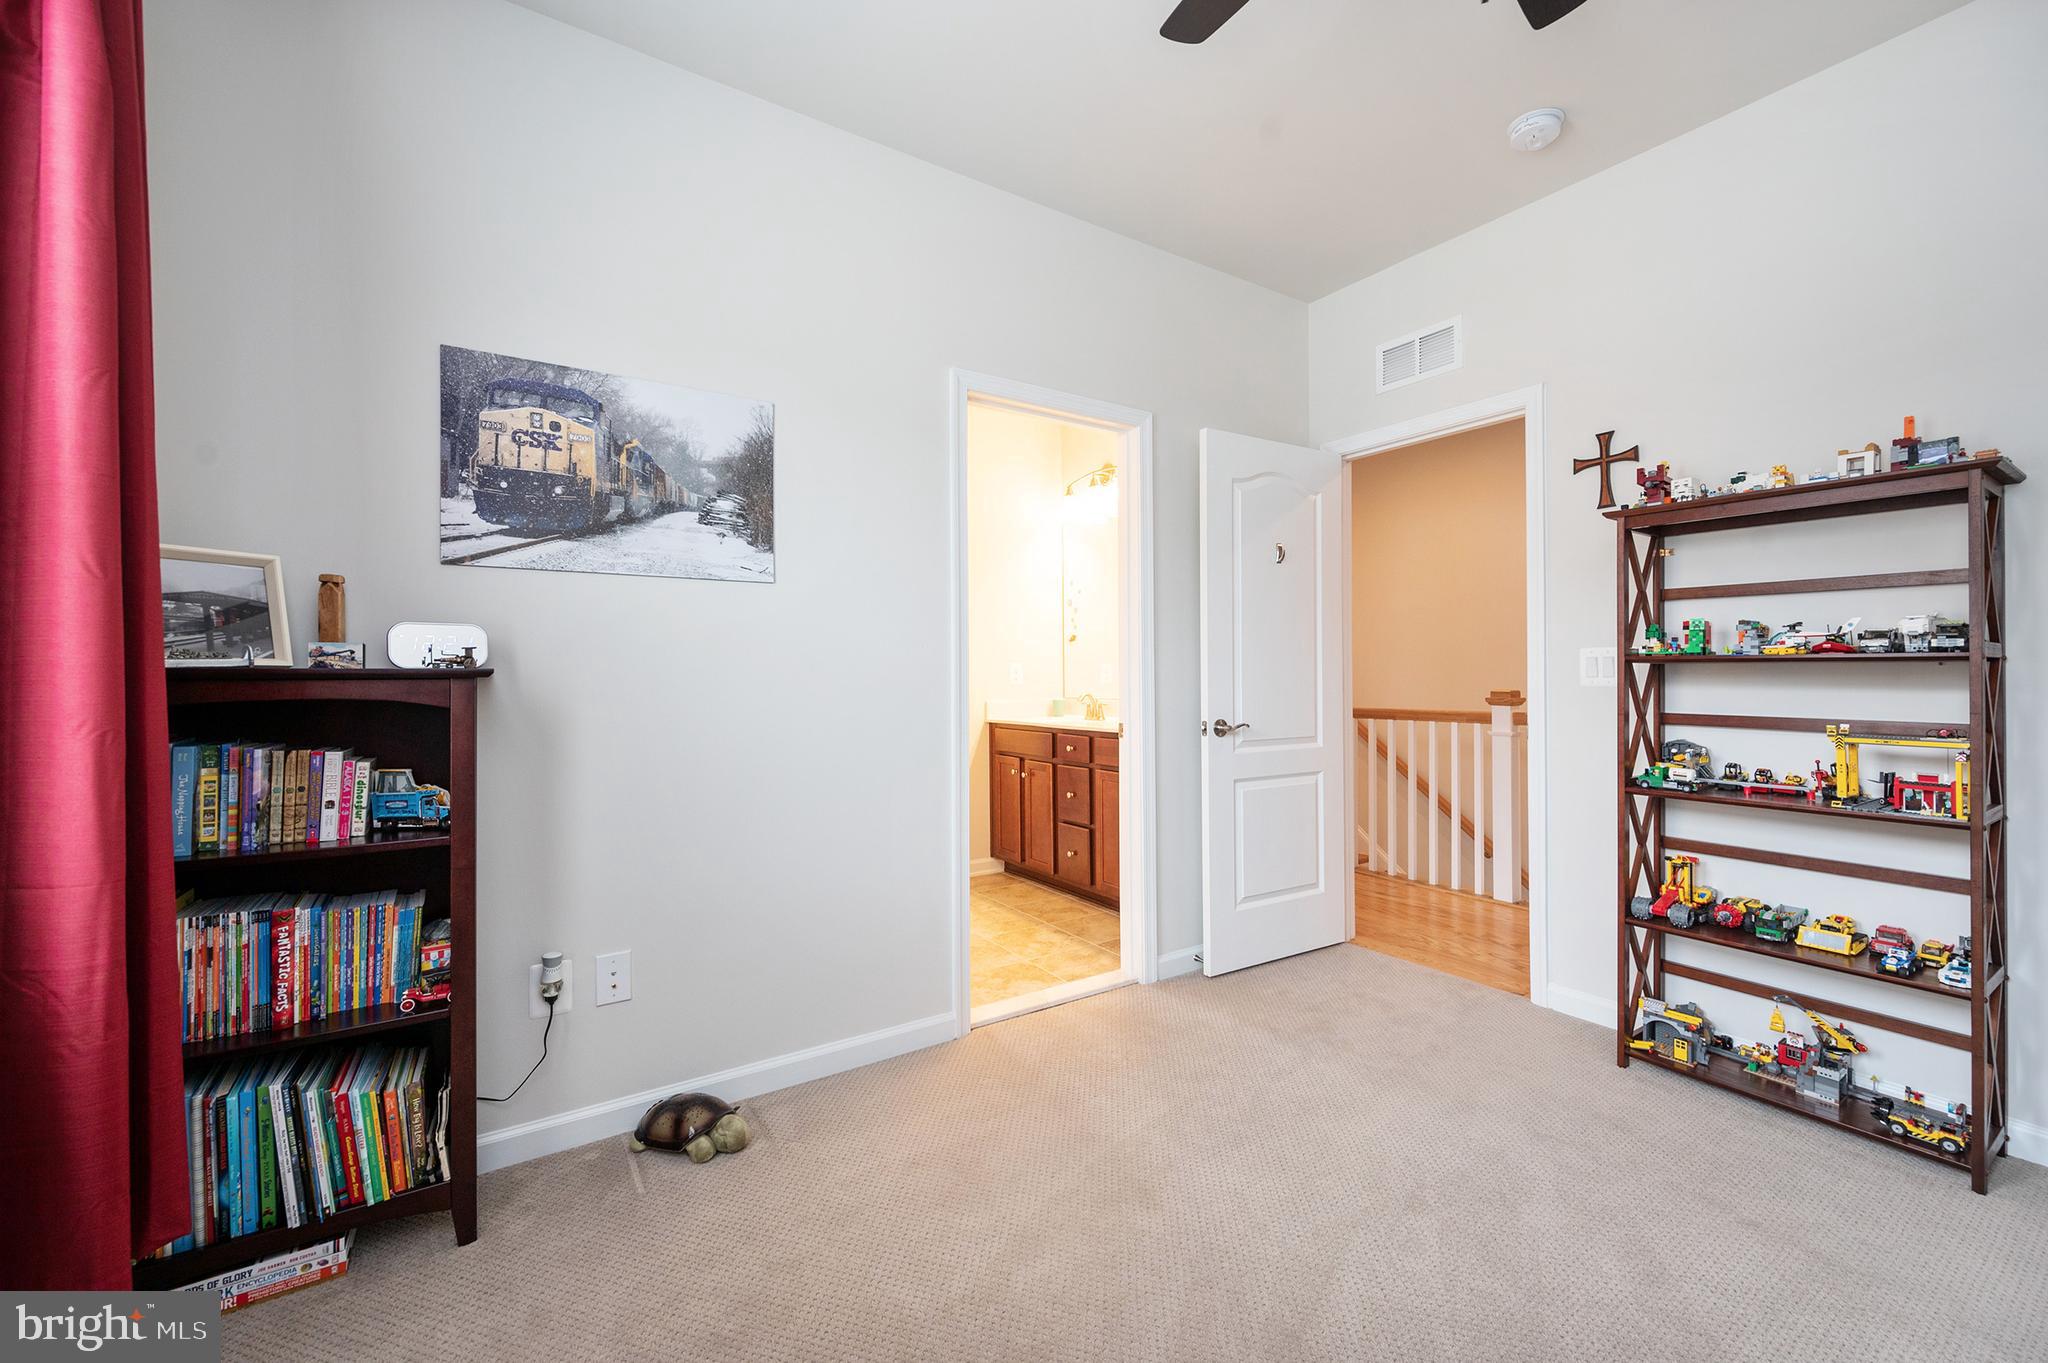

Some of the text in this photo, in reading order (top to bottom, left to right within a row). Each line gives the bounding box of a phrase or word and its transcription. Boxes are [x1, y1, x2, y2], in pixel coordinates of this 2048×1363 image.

[511, 428, 562, 451] CSX
[342, 765, 353, 792] ALASKA
[175, 788, 189, 814] Napping
[176, 813, 188, 836] House
[275, 925, 290, 1012] FANTASTIC FACTS
[412, 1097, 421, 1112] How
[411, 1112, 421, 1124] Big
[414, 1130, 423, 1148] Love?
[207, 1279, 220, 1289] OF
[222, 1269, 253, 1284] GLORY
[236, 1267, 298, 1290] ENCYCLOPEDIA
